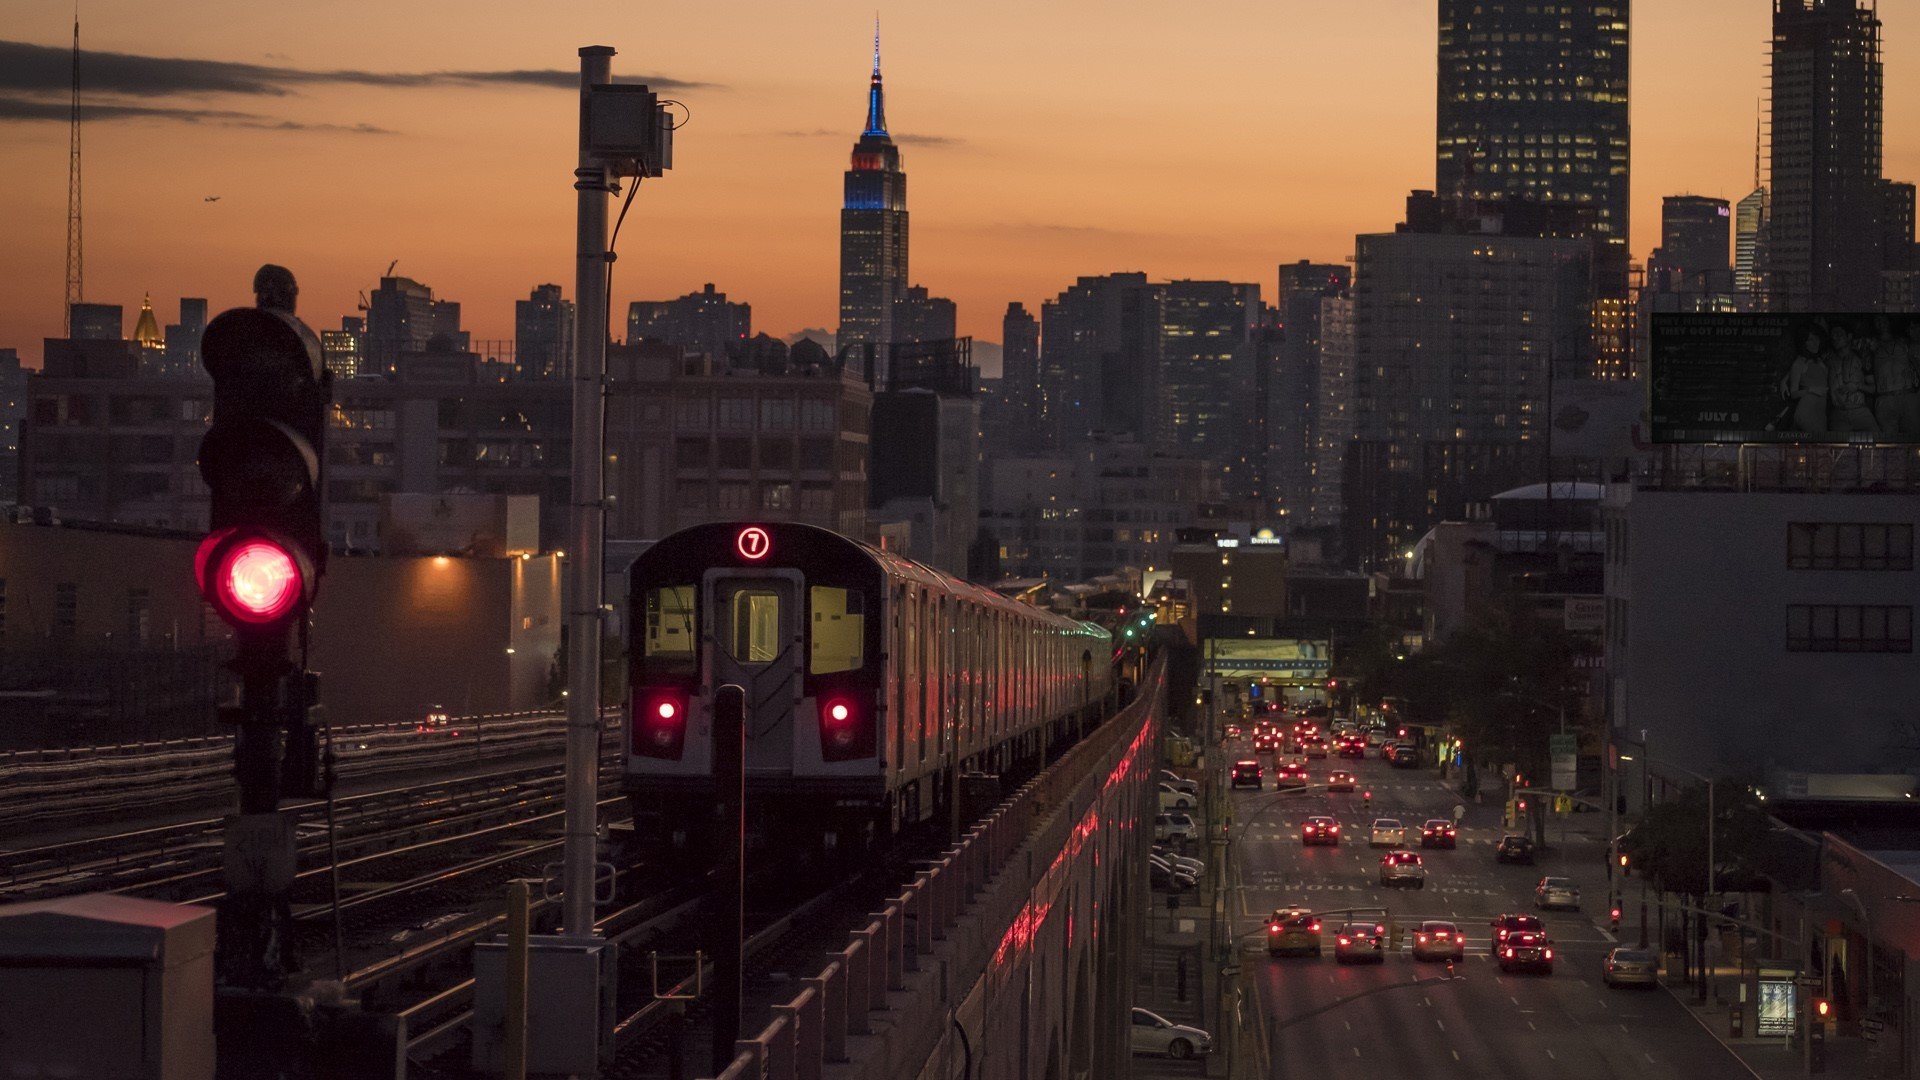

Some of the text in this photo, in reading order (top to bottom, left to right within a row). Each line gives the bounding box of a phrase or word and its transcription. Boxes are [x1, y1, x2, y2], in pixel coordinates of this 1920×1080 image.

[1757, 317, 1789, 326] GIRLS
[1660, 326, 1782, 337] THEY GOT HOT MESSES
[1697, 411, 1740, 422] JULY 8
[747, 533, 760, 552] 7
